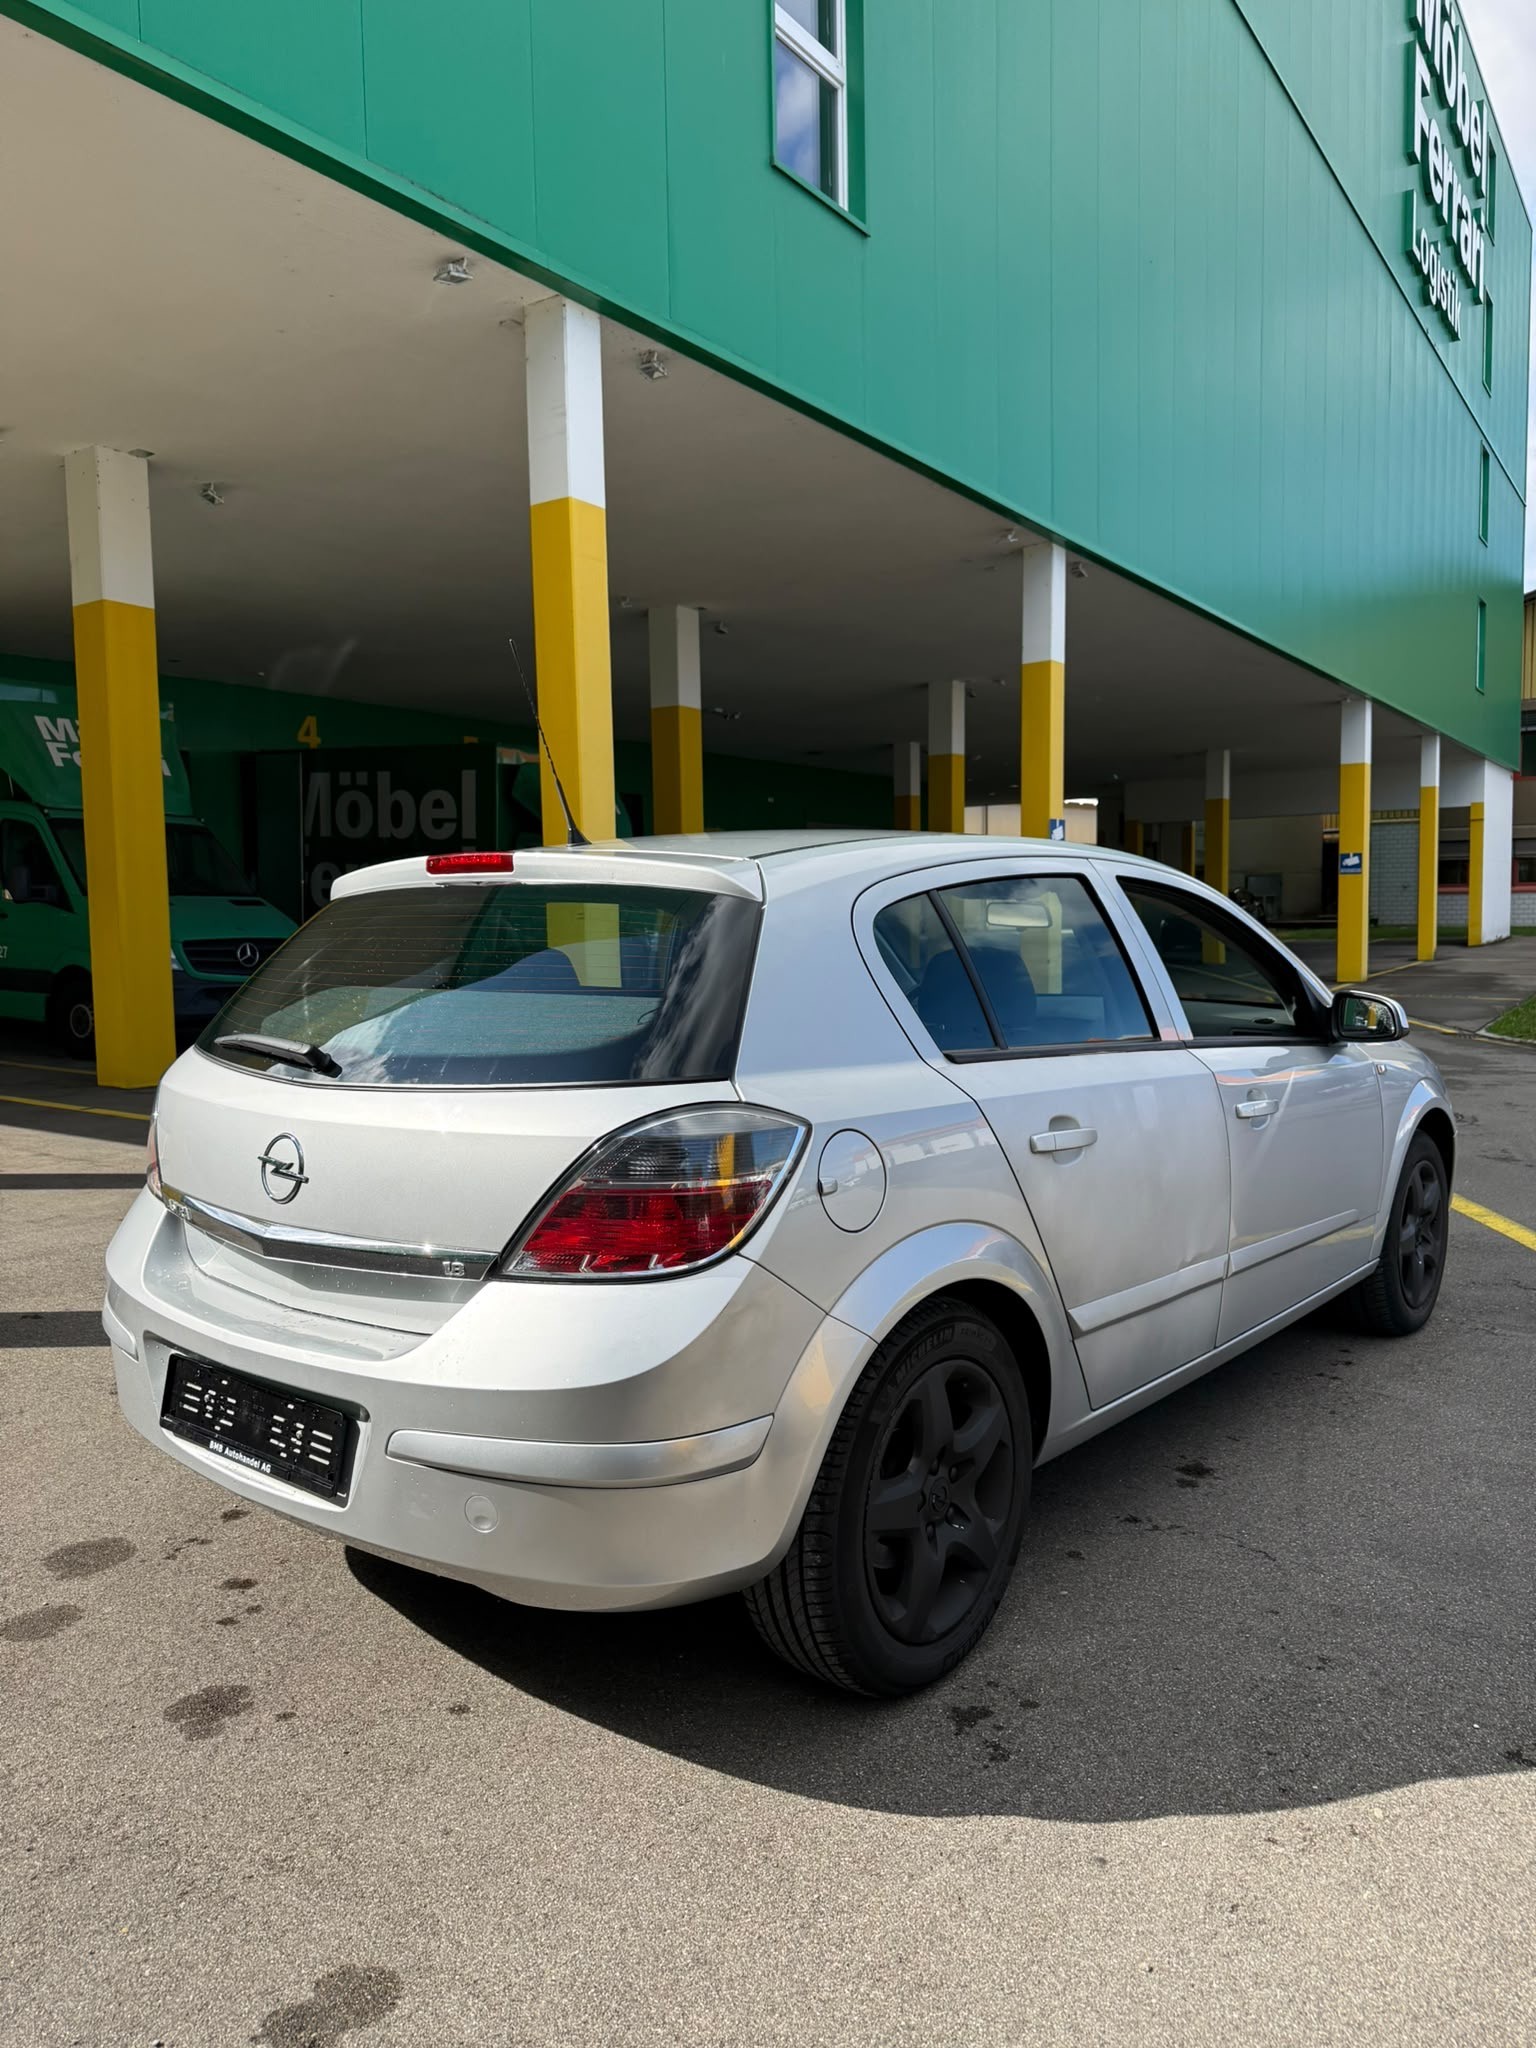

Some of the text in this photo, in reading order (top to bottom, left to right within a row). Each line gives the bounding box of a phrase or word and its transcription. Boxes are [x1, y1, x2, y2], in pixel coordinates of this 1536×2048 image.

[1414, 41, 1486, 304] Ferrari
[1414, 189, 1461, 339] Logistik
[297, 715, 322, 749] 4
[209, 1440, 272, 1474] BMB Autohandel AG
